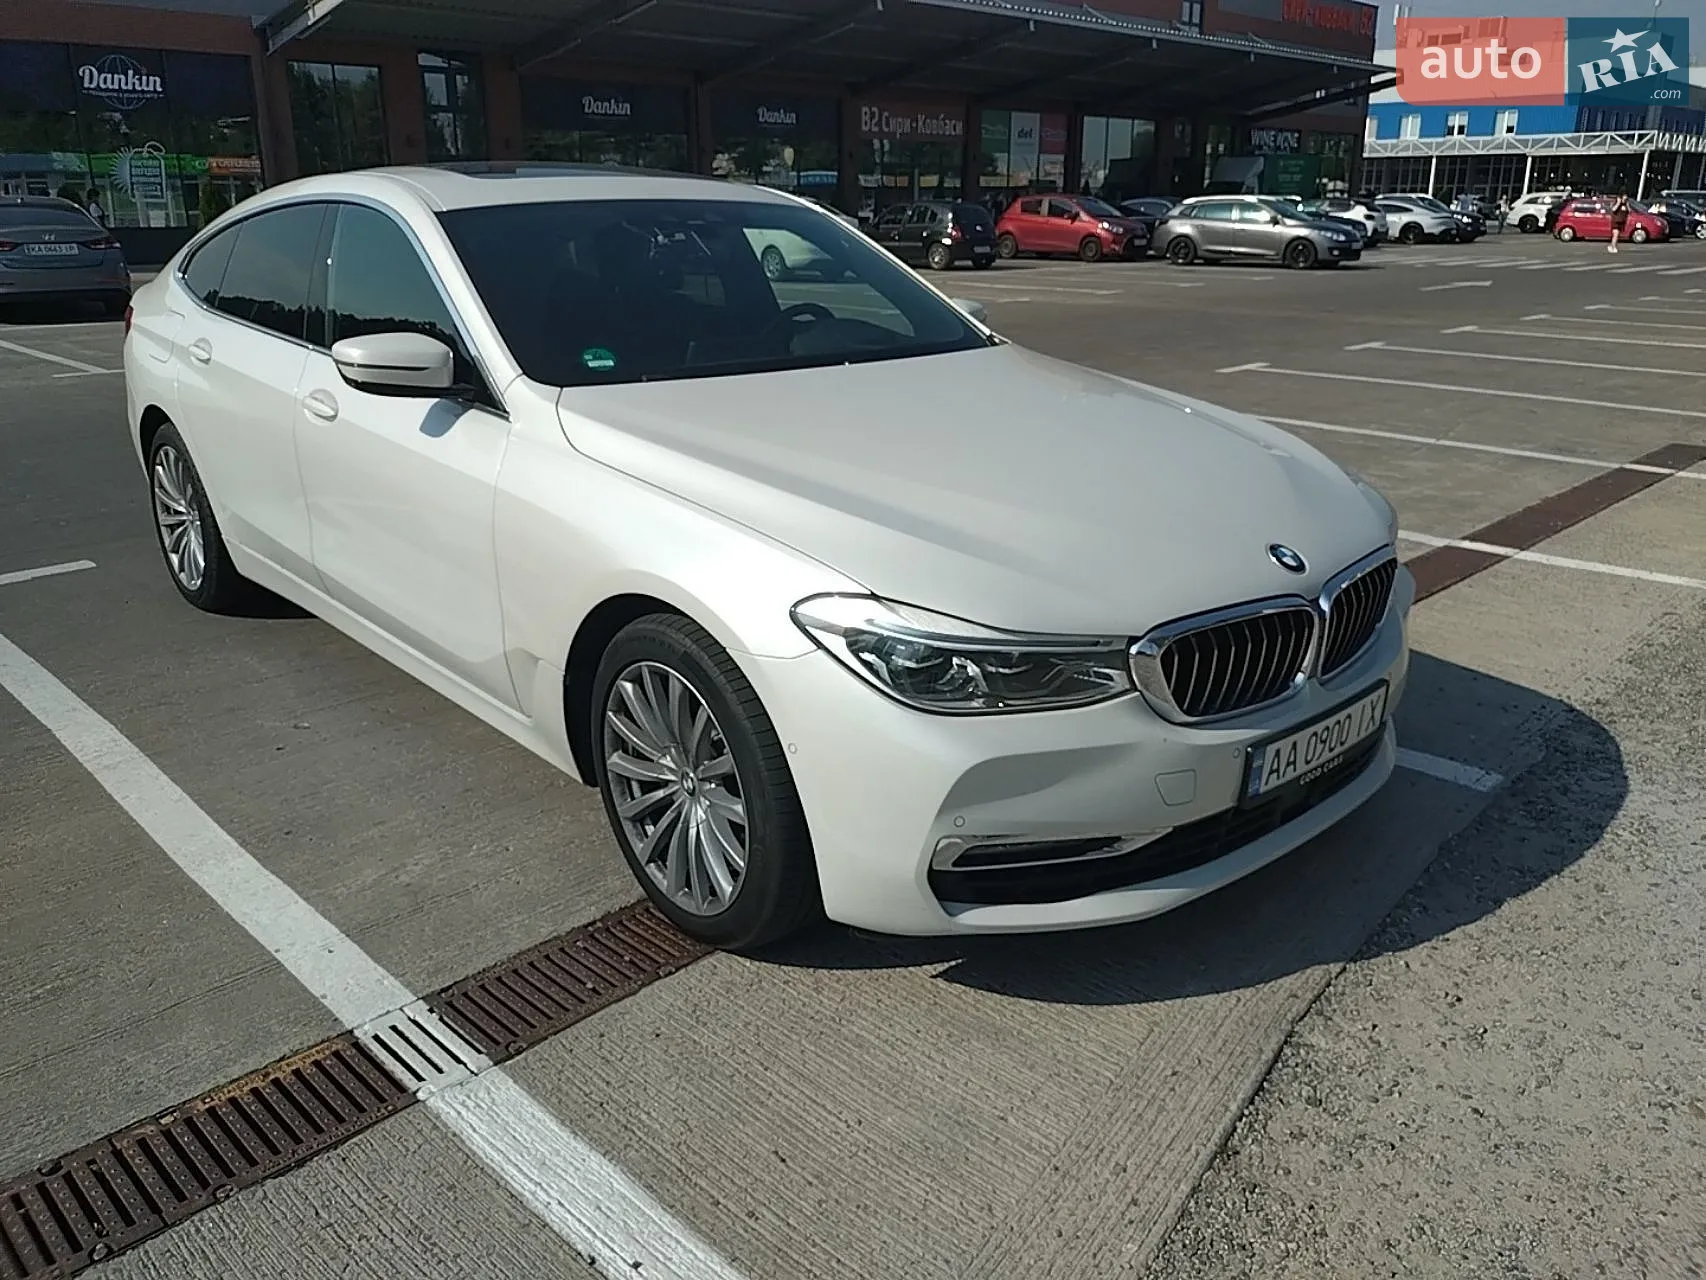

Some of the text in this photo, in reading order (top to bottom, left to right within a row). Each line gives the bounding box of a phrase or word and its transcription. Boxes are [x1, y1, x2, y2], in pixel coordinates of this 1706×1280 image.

[77, 64, 164, 92] Dankin
[581, 96, 631, 116] Dankin
[756, 105, 797, 125] Dankin
[1264, 695, 1382, 786] AA 0900 IX
